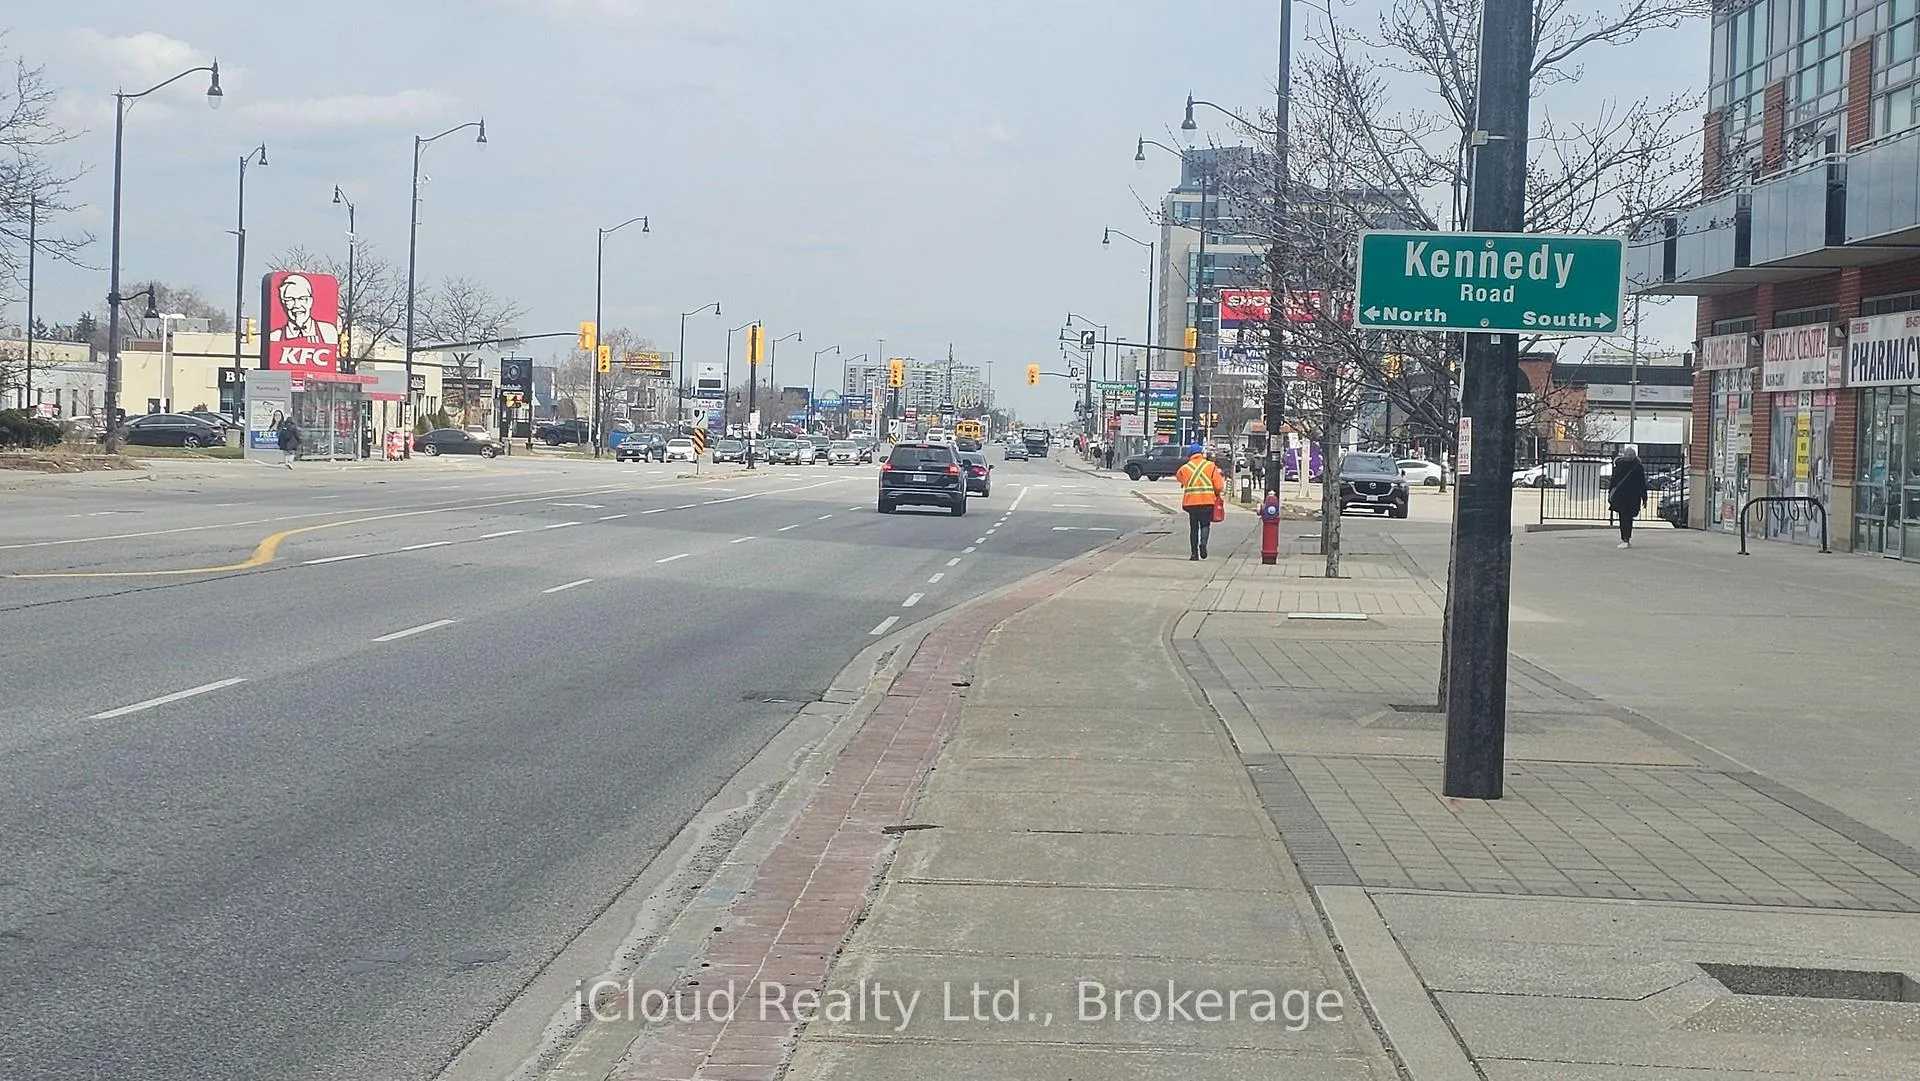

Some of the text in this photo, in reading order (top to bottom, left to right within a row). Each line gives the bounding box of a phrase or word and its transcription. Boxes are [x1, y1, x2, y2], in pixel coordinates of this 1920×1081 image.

[1405, 241, 1574, 288] Kennedy
[1460, 283, 1515, 303] Road
[1383, 307, 1592, 328] North South
[1765, 331, 1796, 362] MEDICAL
[1797, 327, 1827, 360] CENTRE
[279, 346, 331, 366] KFC
